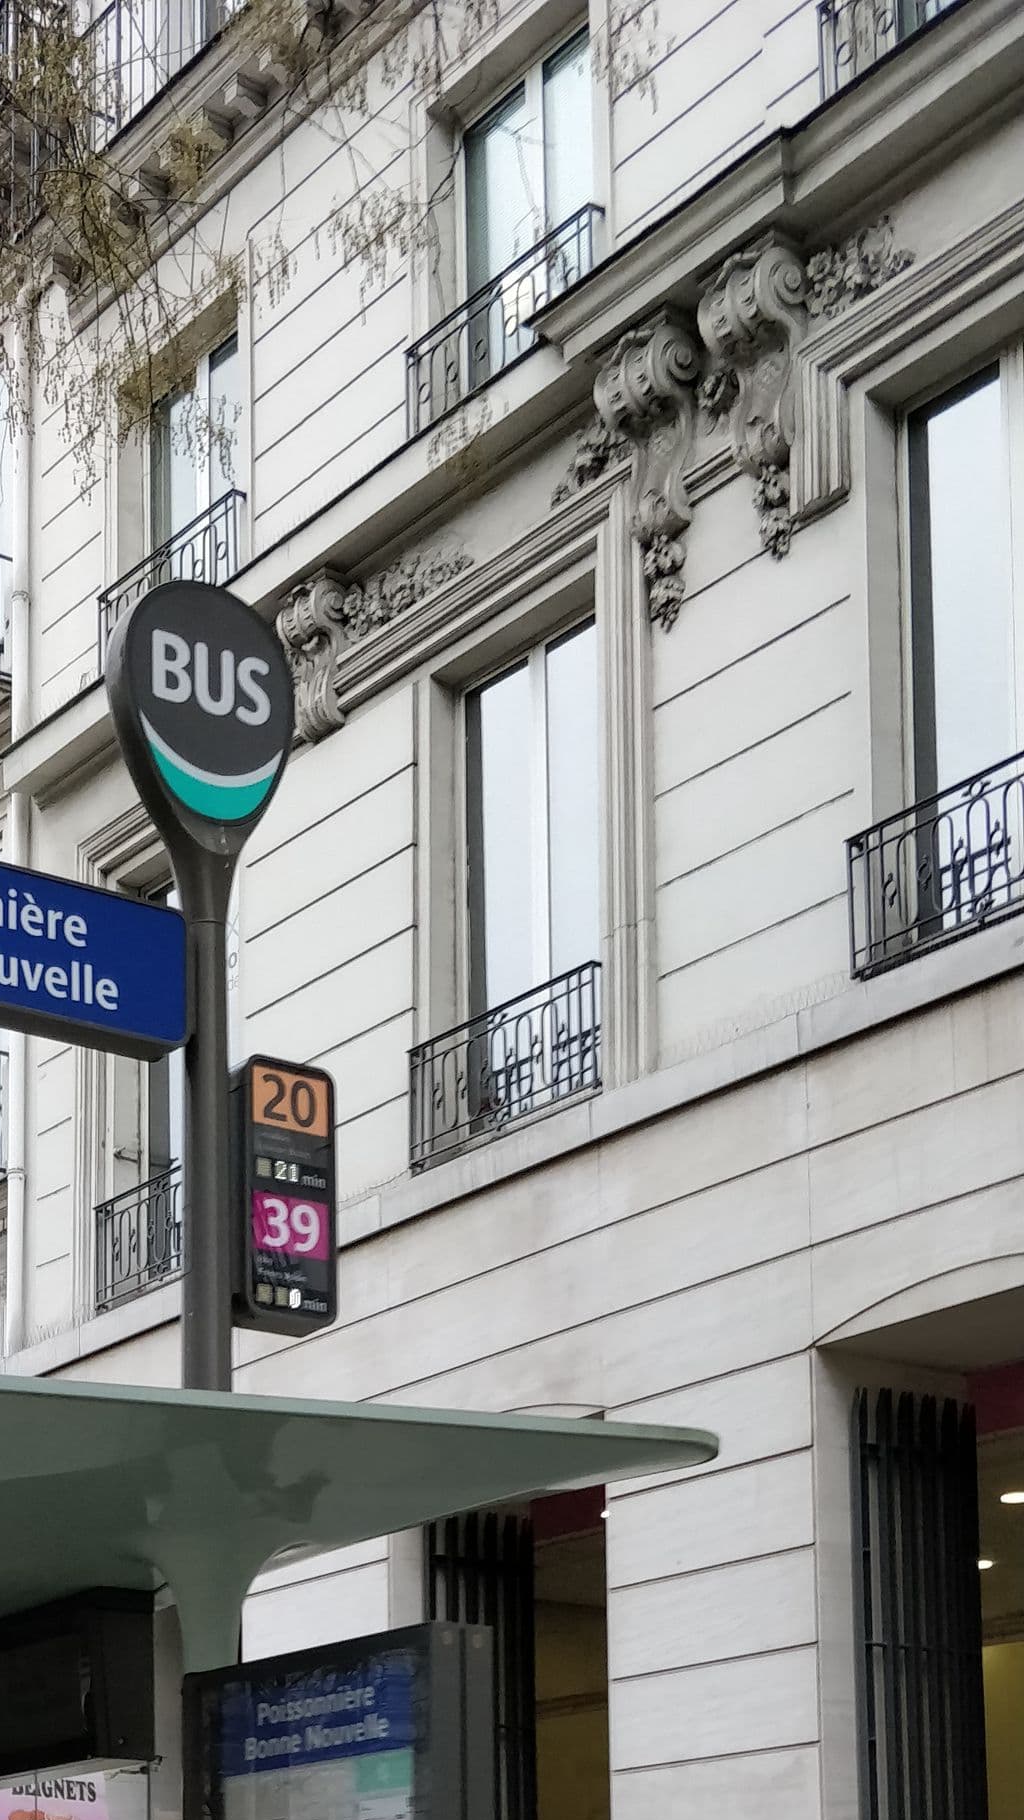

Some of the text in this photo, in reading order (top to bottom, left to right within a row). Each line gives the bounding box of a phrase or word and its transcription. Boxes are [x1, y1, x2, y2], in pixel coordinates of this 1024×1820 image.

[152, 628, 271, 727] BUS
[262, 1073, 317, 1128] 20
[274, 1160, 327, 1190] 21 min
[262, 1197, 321, 1253] 39
[303, 1297, 328, 1314] min
[256, 1685, 376, 1727] Poissonnière
[243, 1713, 390, 1761] Bonne Nouvelle
